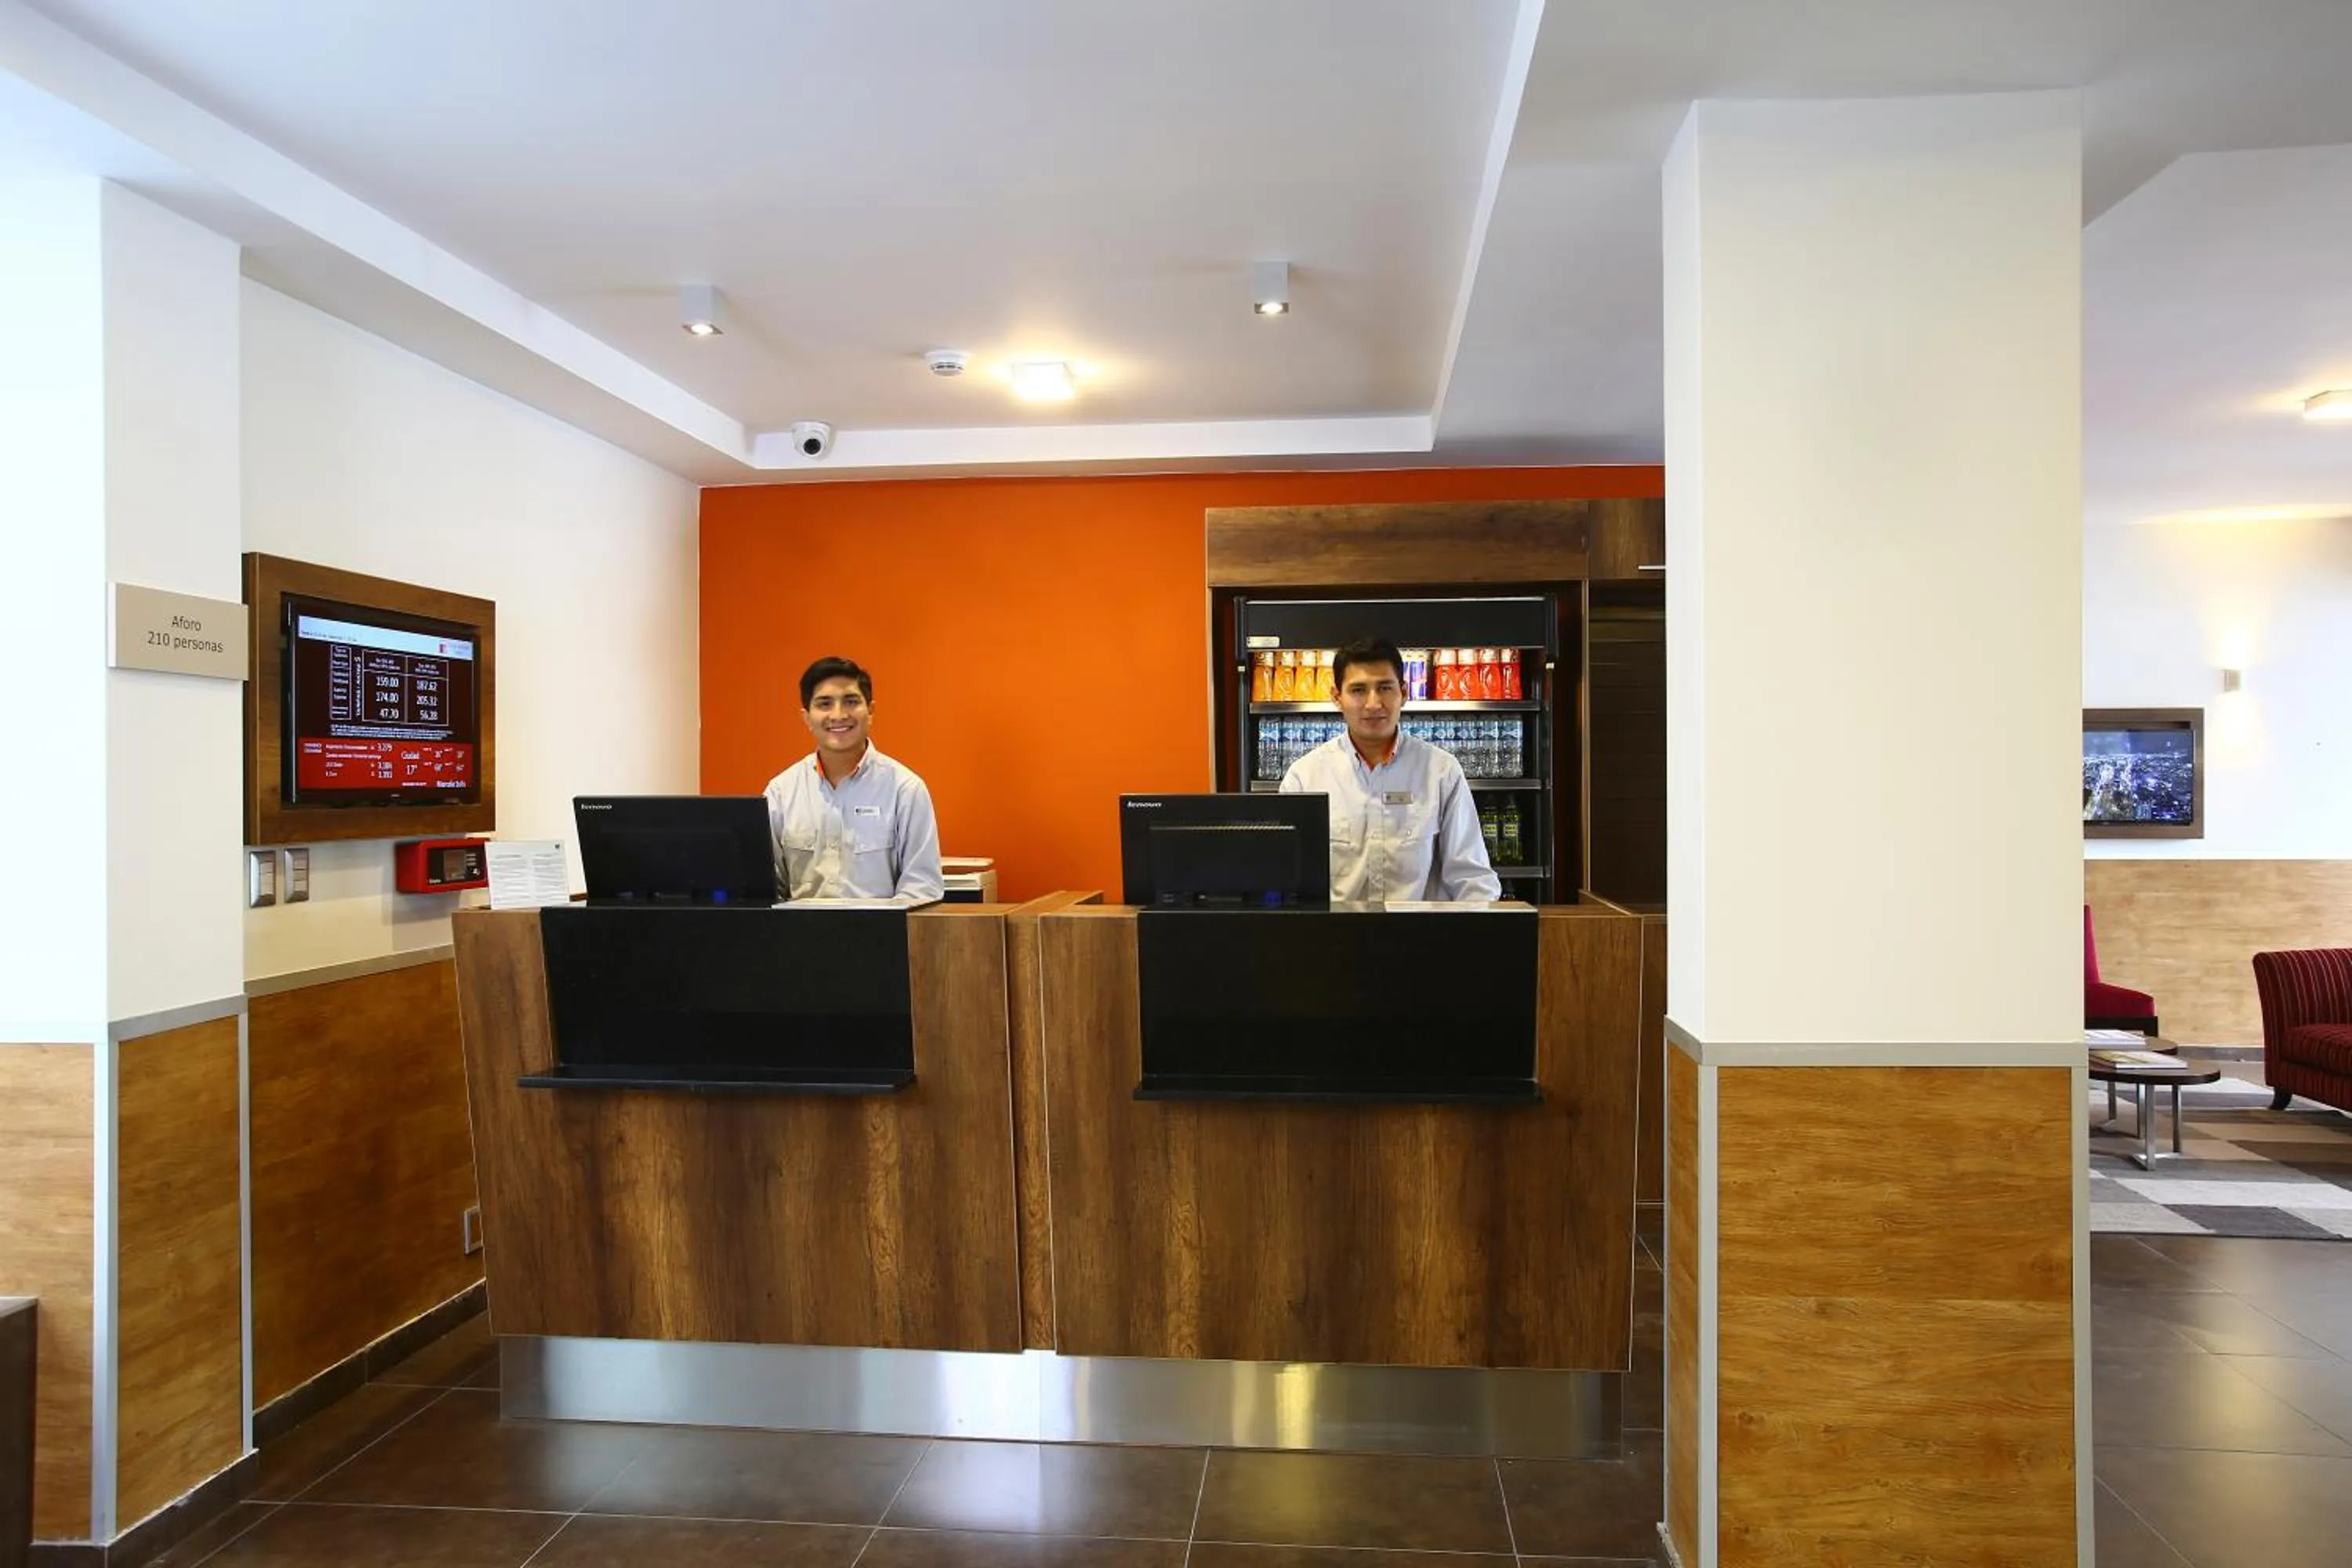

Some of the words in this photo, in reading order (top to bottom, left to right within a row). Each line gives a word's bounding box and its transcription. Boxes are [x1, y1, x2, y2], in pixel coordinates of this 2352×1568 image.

[172, 615, 201, 631] Aforo
[147, 630, 170, 646] 210
[174, 637, 223, 653] personas
